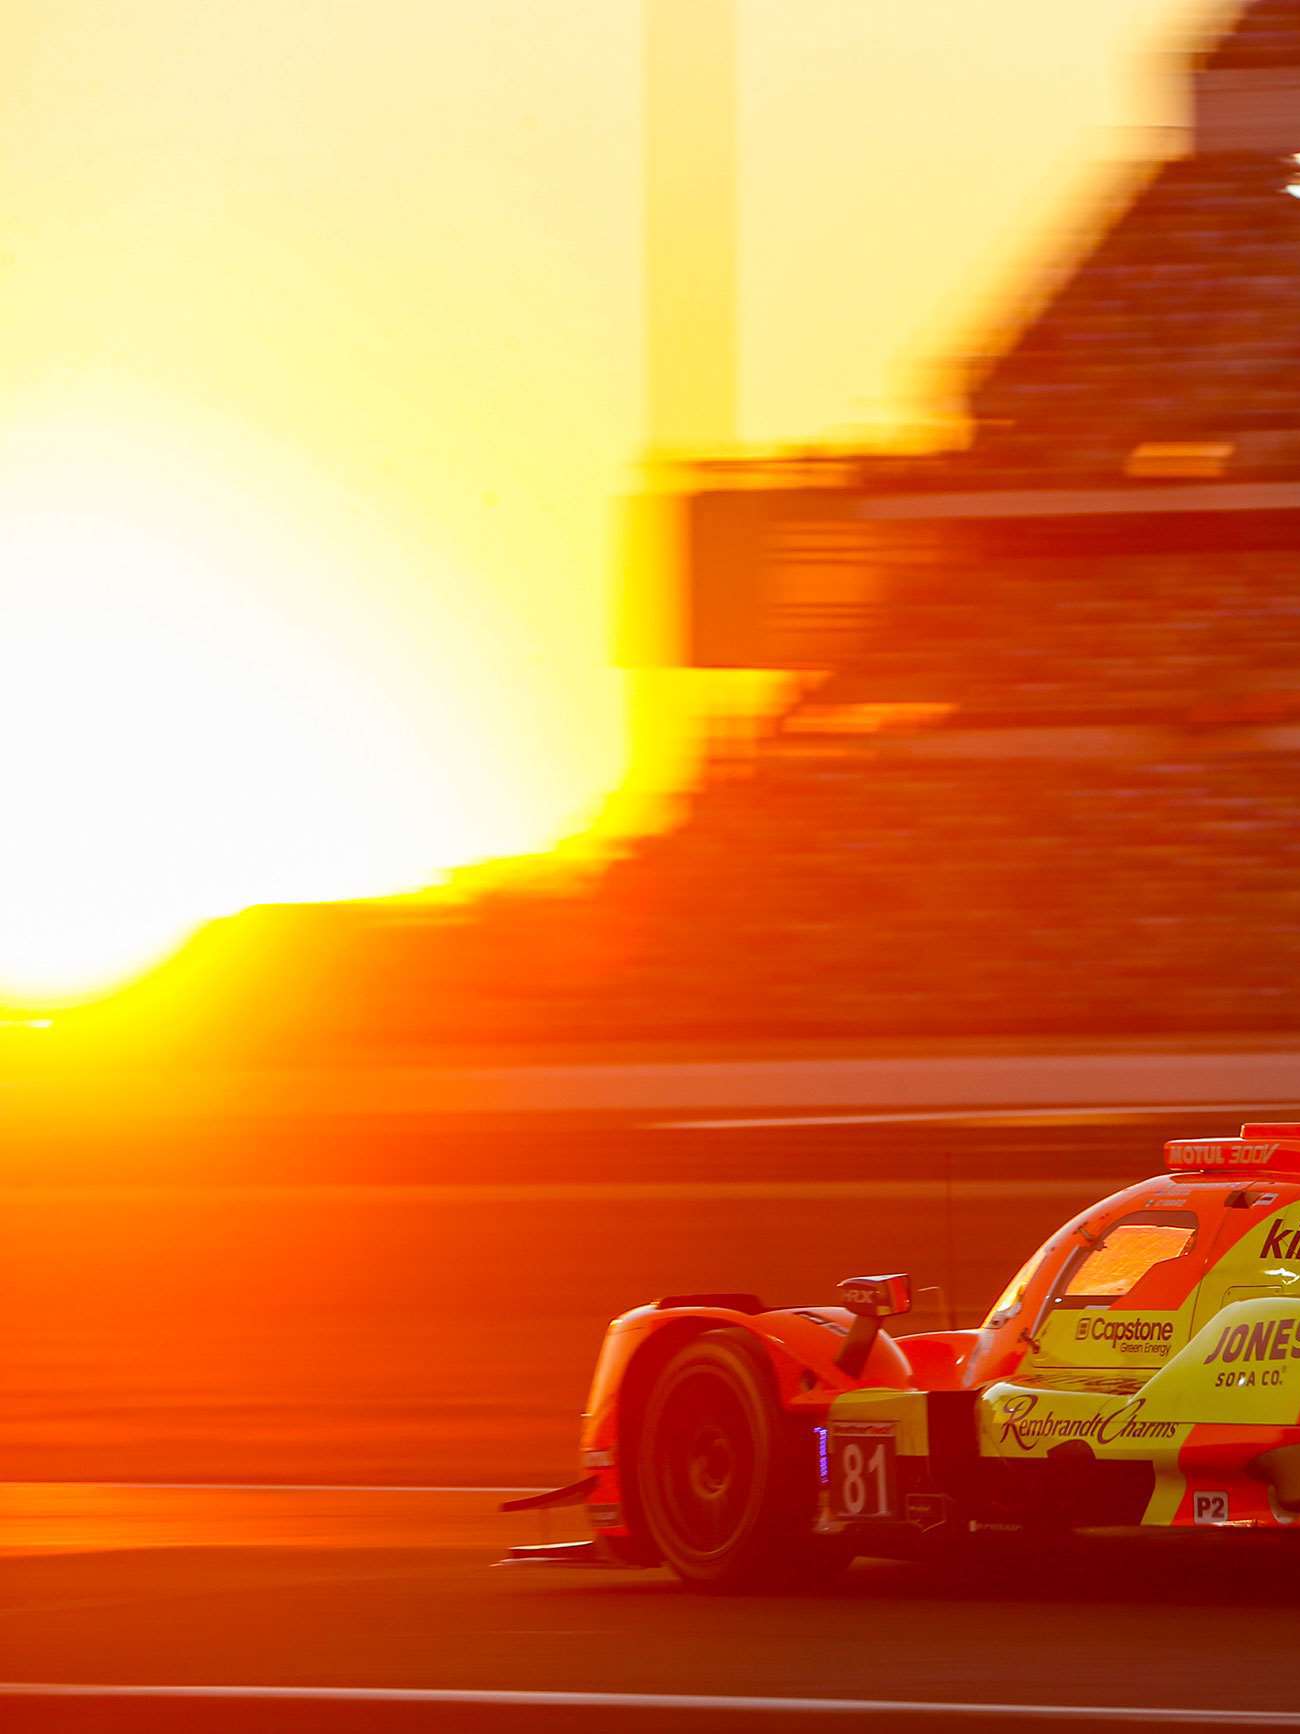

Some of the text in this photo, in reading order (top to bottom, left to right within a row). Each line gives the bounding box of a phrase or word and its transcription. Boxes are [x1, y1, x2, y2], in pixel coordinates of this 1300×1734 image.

[1168, 1145, 1225, 1165] MOTUL
[1090, 1317, 1174, 1349] Capstone
[1119, 1342, 1172, 1357] Green Energy
[842, 1443, 894, 1517] 81
[1196, 1497, 1225, 1518] P2
